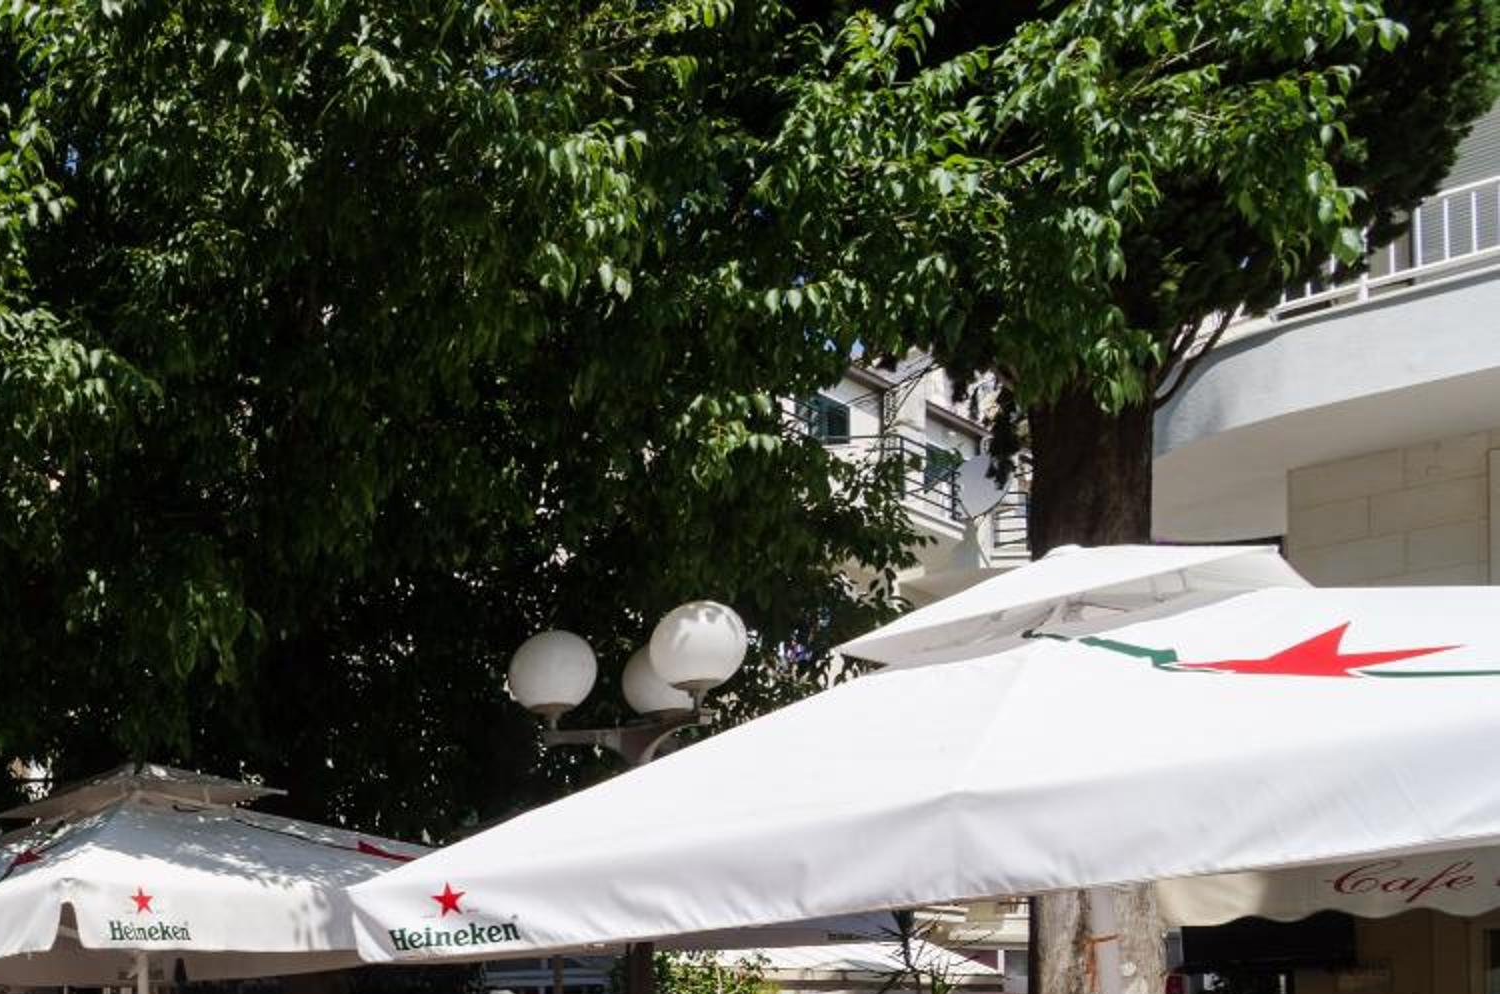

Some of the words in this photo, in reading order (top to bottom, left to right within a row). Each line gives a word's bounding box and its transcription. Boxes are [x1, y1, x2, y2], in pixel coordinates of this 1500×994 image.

[1325, 858, 1474, 903] Café
[109, 920, 192, 941] Heineken
[388, 922, 520, 951] Heineken
